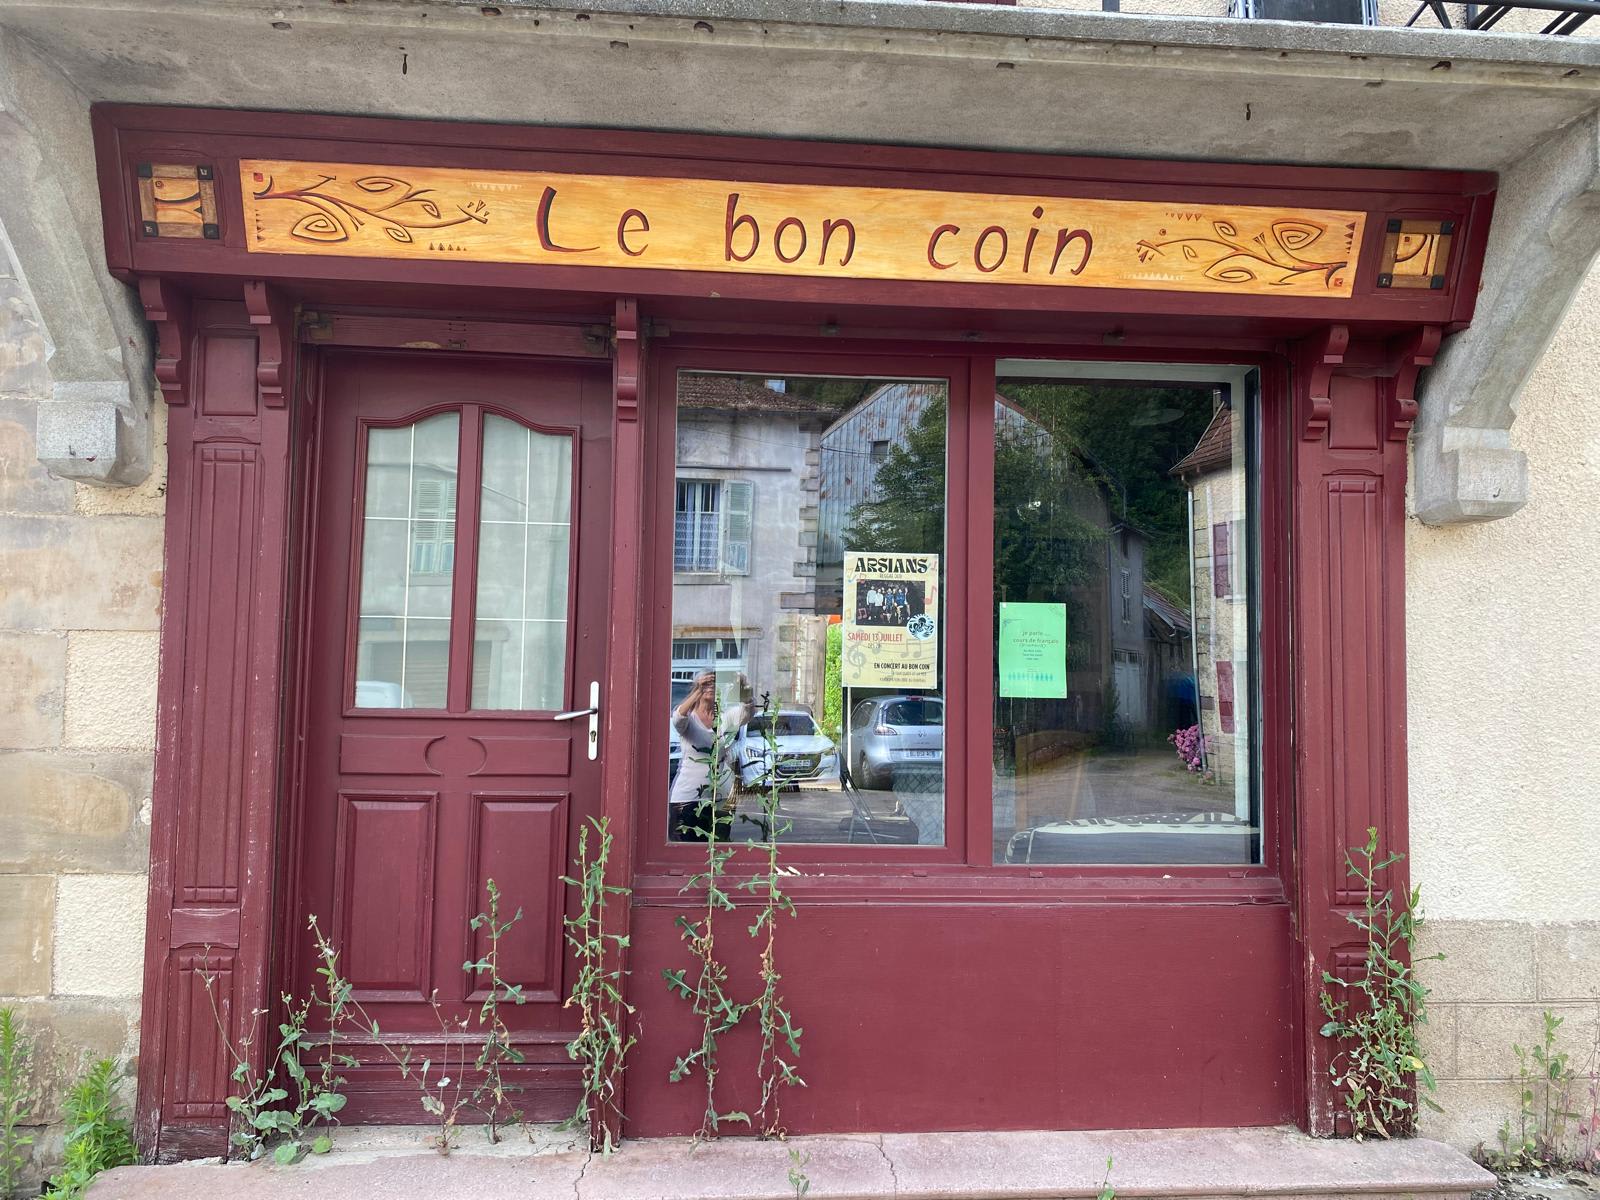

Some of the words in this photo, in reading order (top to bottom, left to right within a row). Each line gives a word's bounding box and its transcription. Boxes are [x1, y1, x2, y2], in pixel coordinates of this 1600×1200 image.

[536, 185, 650, 257] Le
[724, 192, 856, 267] bon
[927, 205, 1094, 276] coin
[854, 557, 928, 574] ARSIANS
[847, 632, 870, 641] SAMEDI
[880, 633, 902, 642] JUILLET
